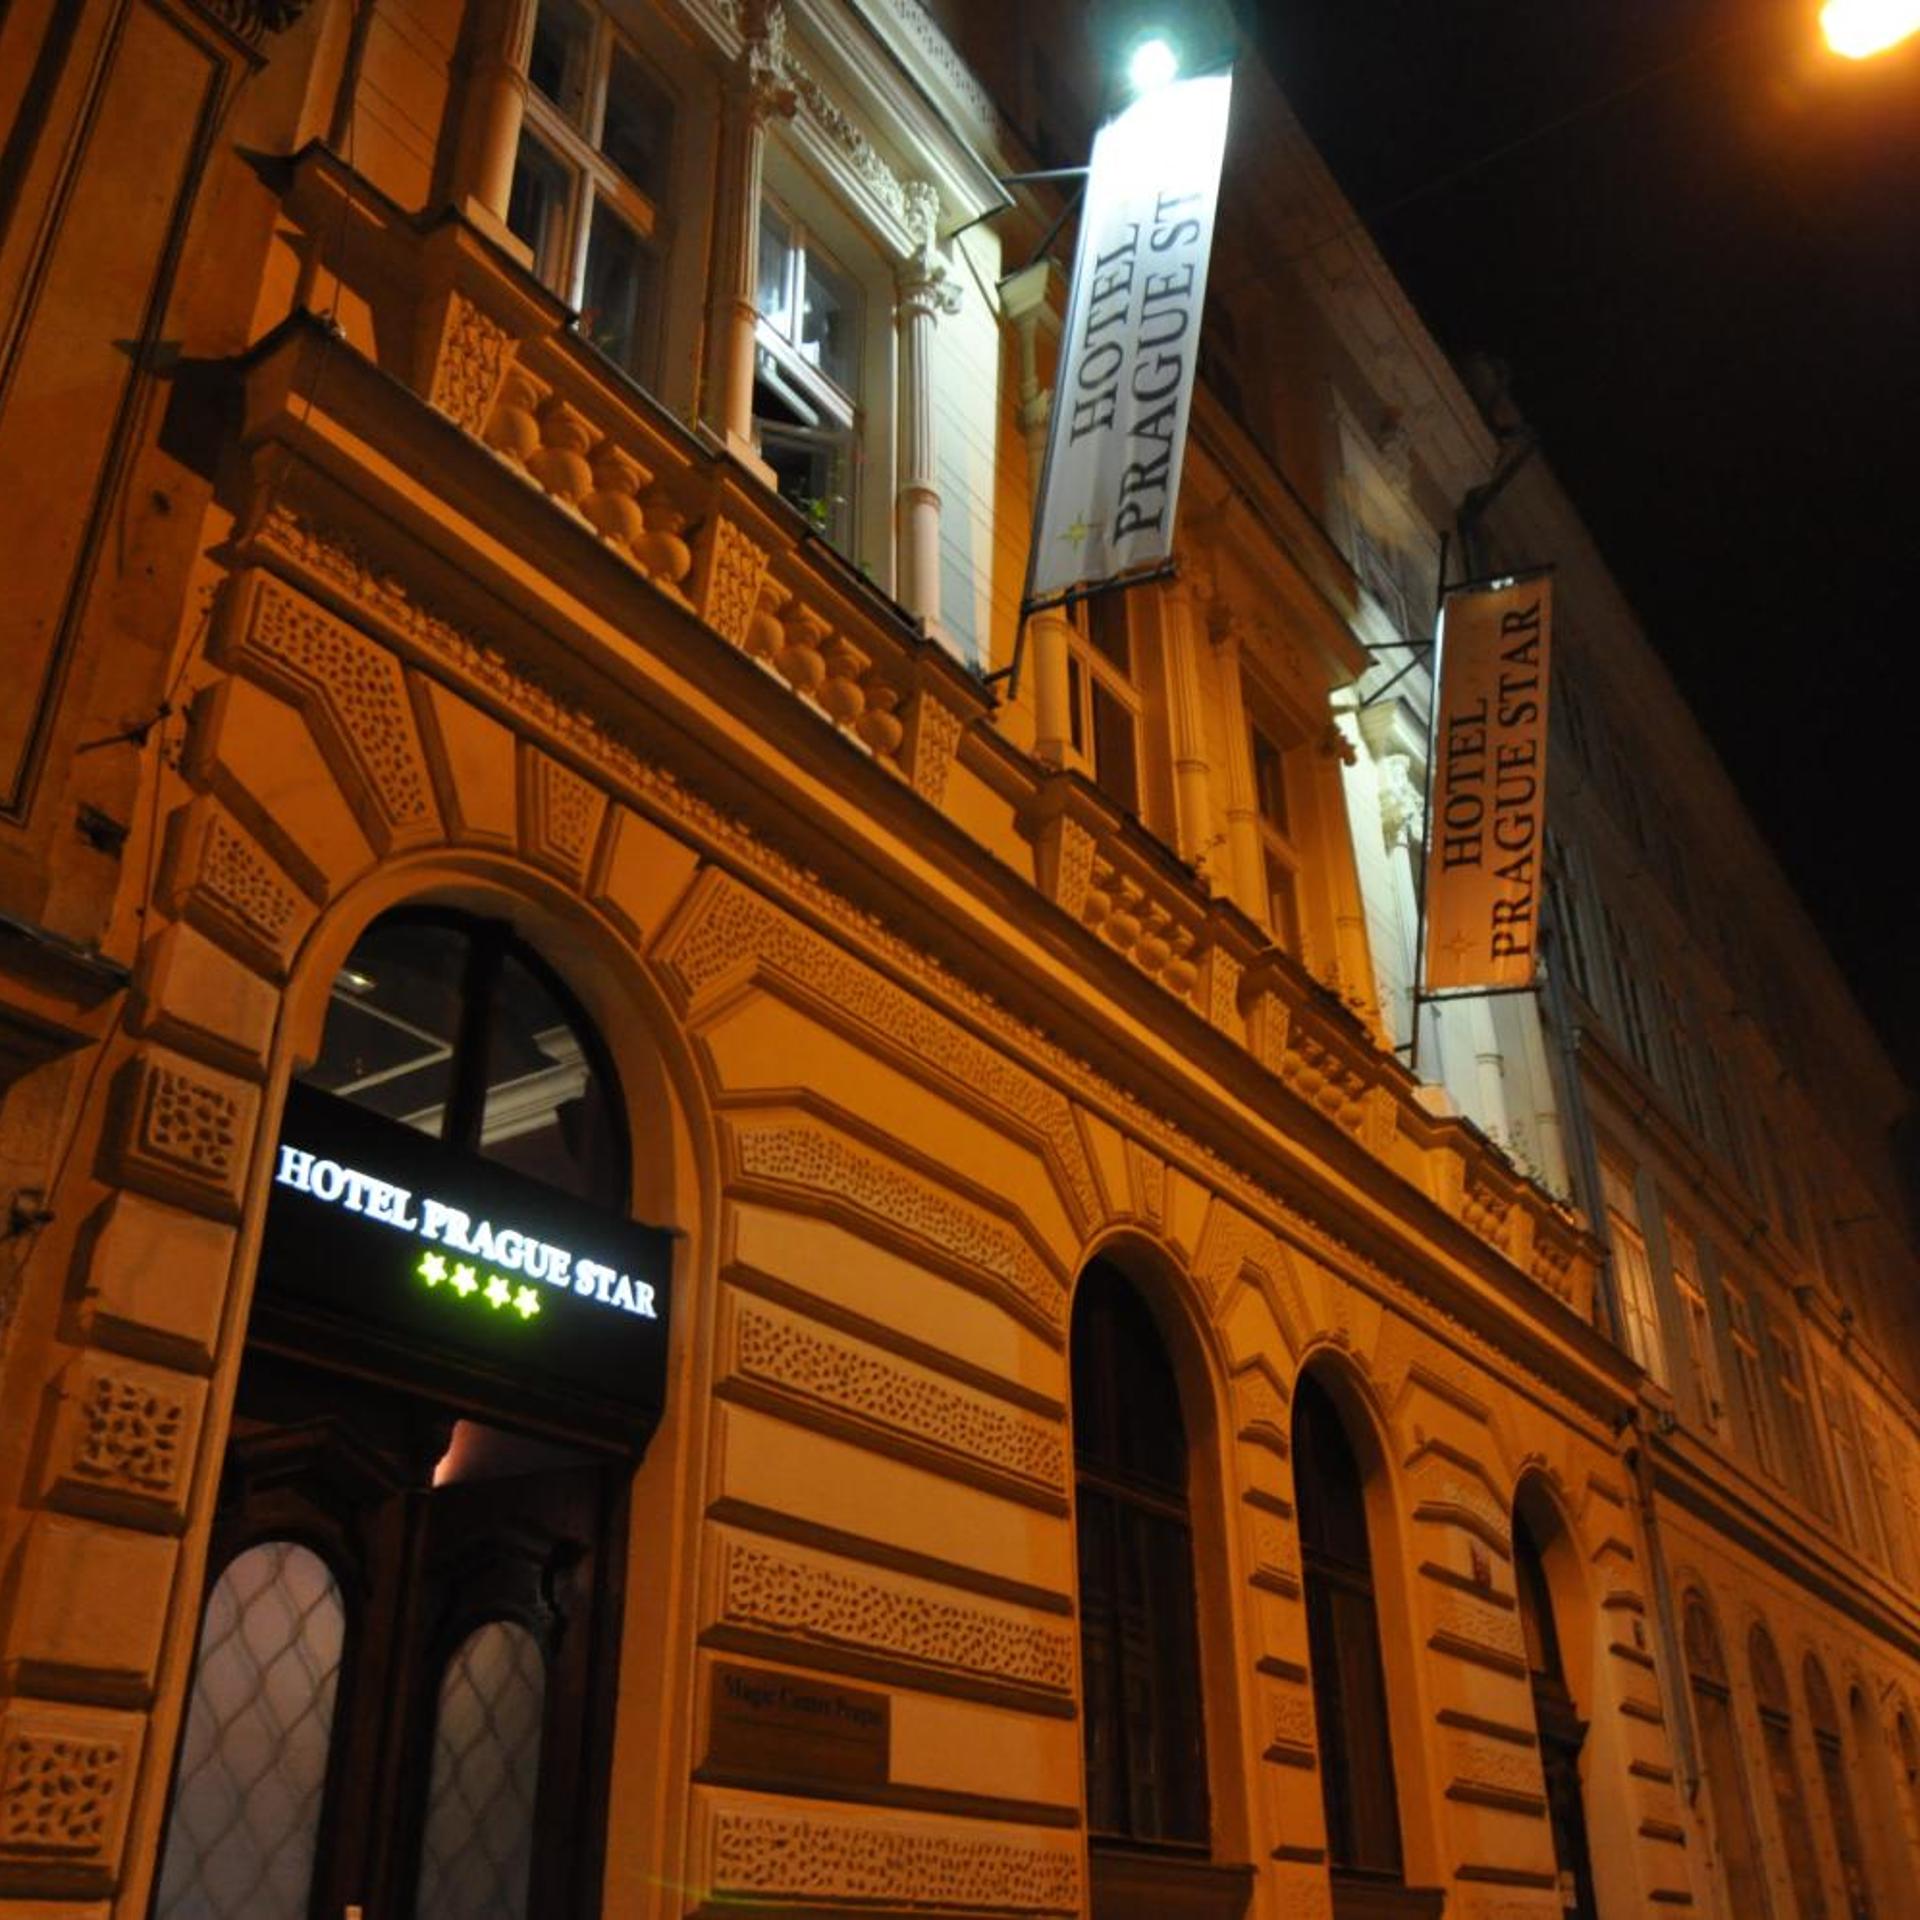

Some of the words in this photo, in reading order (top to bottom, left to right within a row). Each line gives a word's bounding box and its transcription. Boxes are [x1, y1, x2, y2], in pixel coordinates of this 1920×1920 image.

[1151, 190, 1204, 262] ST
[1071, 224, 1140, 447] HOTEL
[1114, 263, 1194, 546] PRAGUE
[1498, 599, 1542, 734] STAR
[1443, 698, 1487, 873] HOTEL
[1491, 739, 1536, 961] PRAGUE
[276, 1145, 418, 1232] HOTEL
[420, 1198, 572, 1288] PRAGUE
[574, 1258, 658, 1319] STAR
